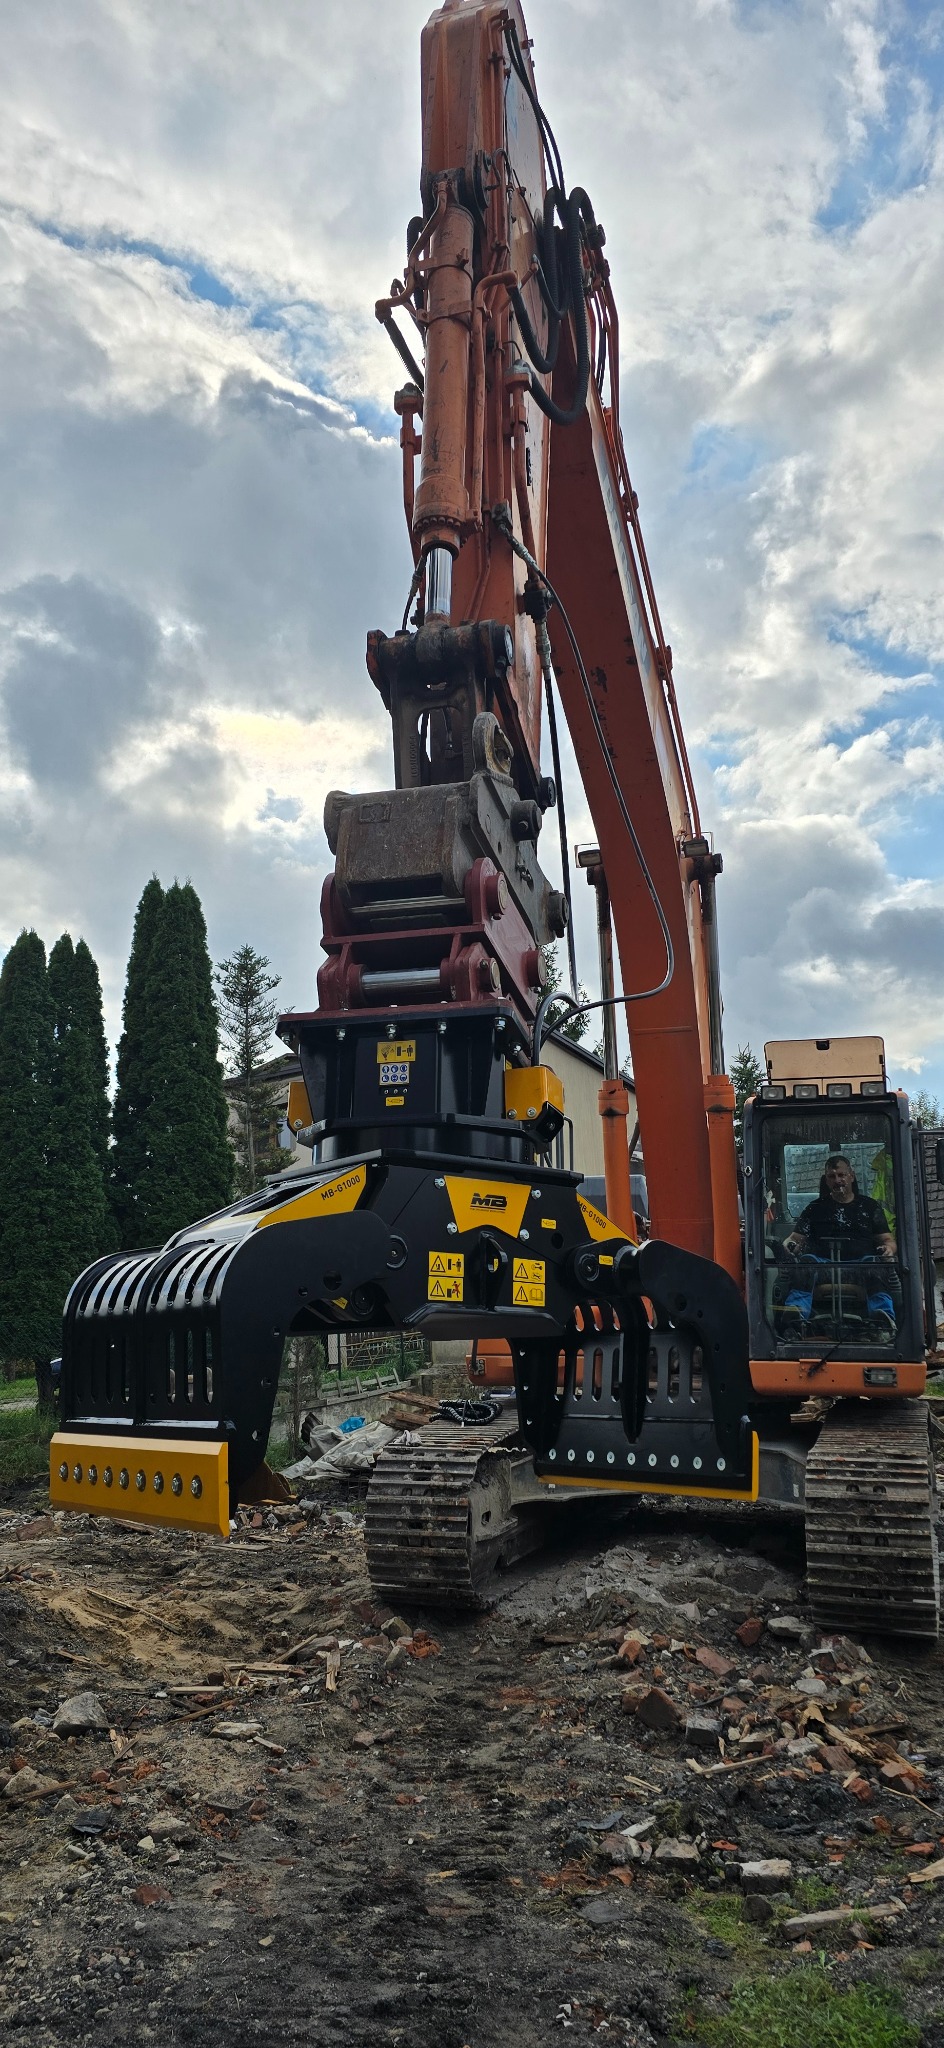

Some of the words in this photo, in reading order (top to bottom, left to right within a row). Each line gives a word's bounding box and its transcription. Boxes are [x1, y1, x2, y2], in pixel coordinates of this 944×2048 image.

[602, 473, 647, 663] DOOSAN
[320, 1175, 361, 1201] MB-G1000
[471, 1192, 507, 1207] MB
